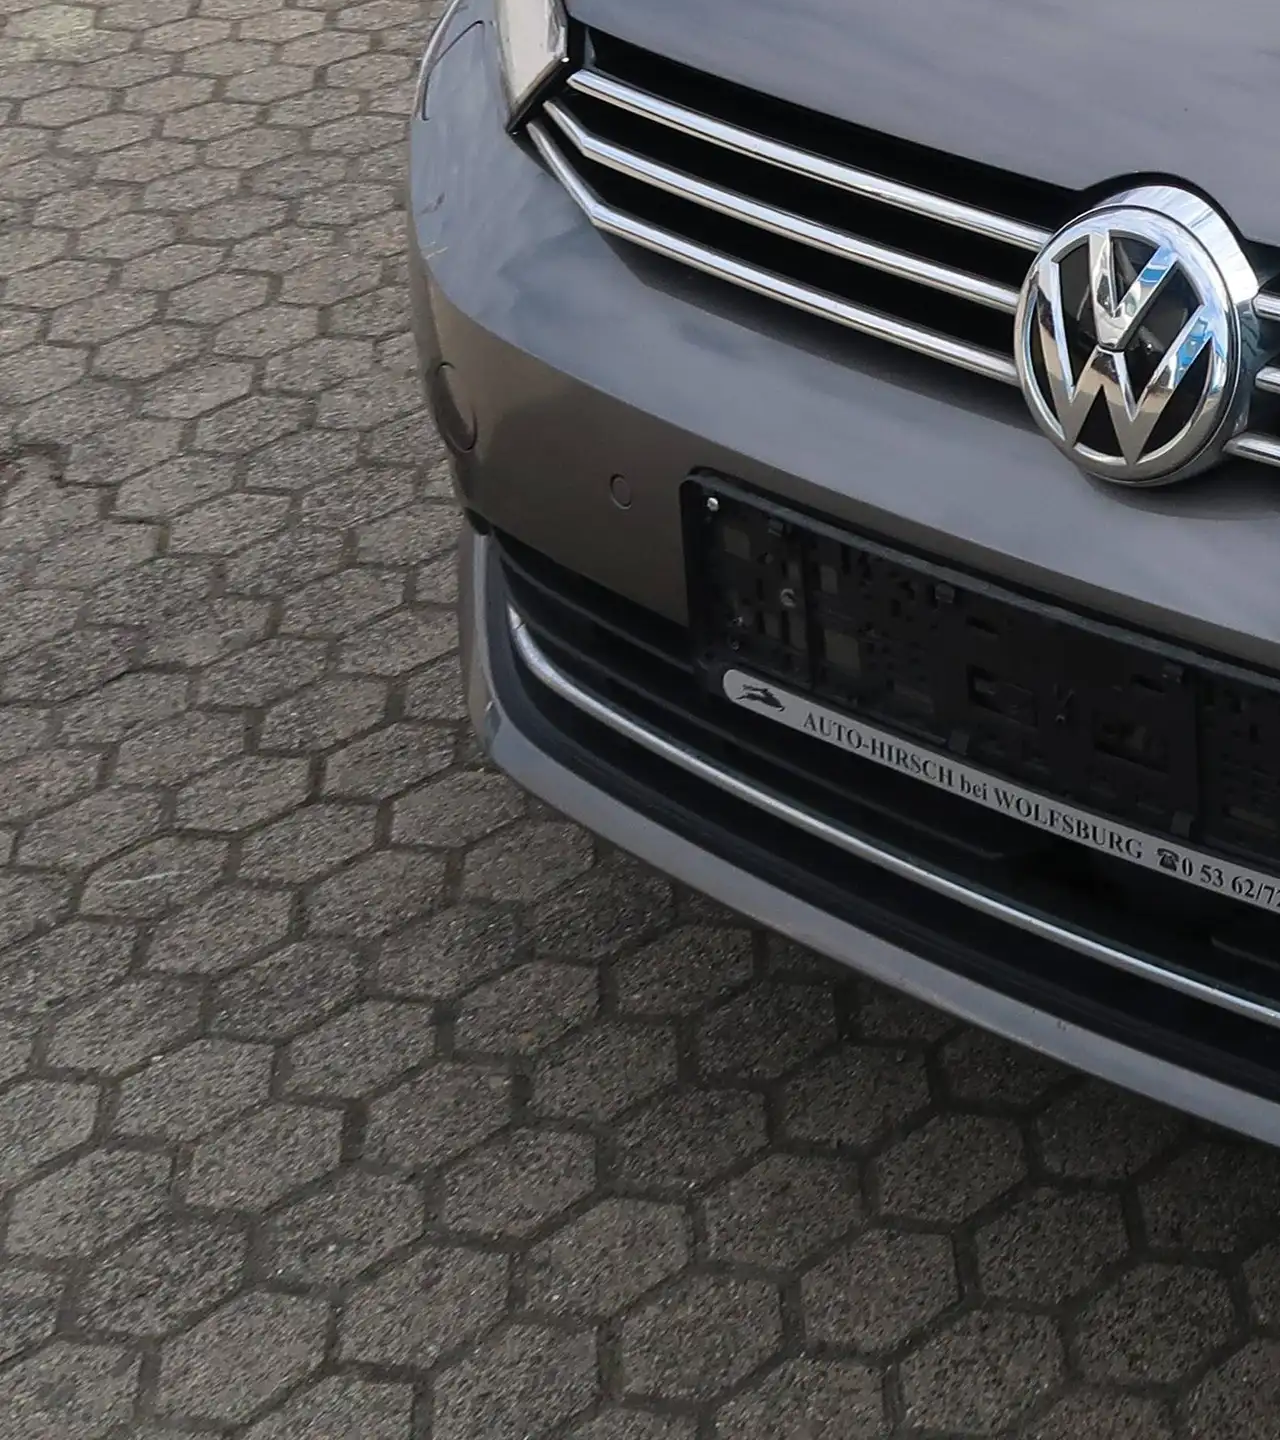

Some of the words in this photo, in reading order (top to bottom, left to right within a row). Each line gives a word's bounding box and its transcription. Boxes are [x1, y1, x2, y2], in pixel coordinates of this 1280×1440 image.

[803, 711, 954, 788] AUTO-HIRSCH
[960, 773, 988, 802] bei
[994, 787, 1144, 861] WOLFSBURG
[1181, 856, 1194, 878] 0
[1200, 863, 1224, 888] 53
